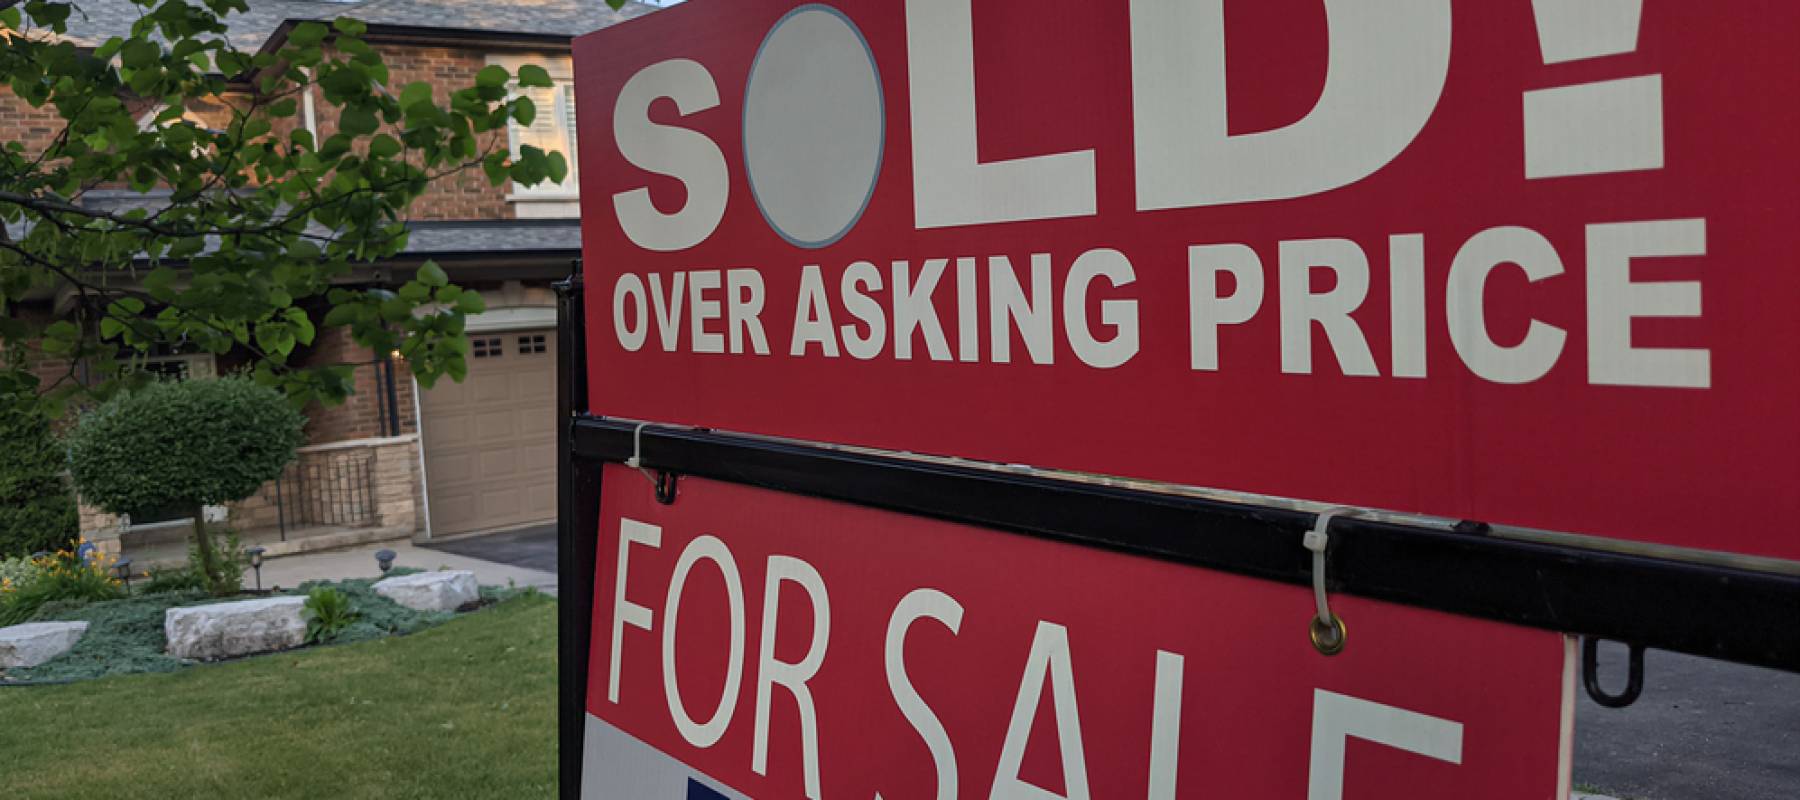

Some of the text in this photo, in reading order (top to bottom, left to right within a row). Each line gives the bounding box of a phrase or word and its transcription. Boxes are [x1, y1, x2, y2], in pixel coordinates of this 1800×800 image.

[613, 218, 1711, 388] OVER ASKING PRICE
[608, 518, 831, 800] FOR
